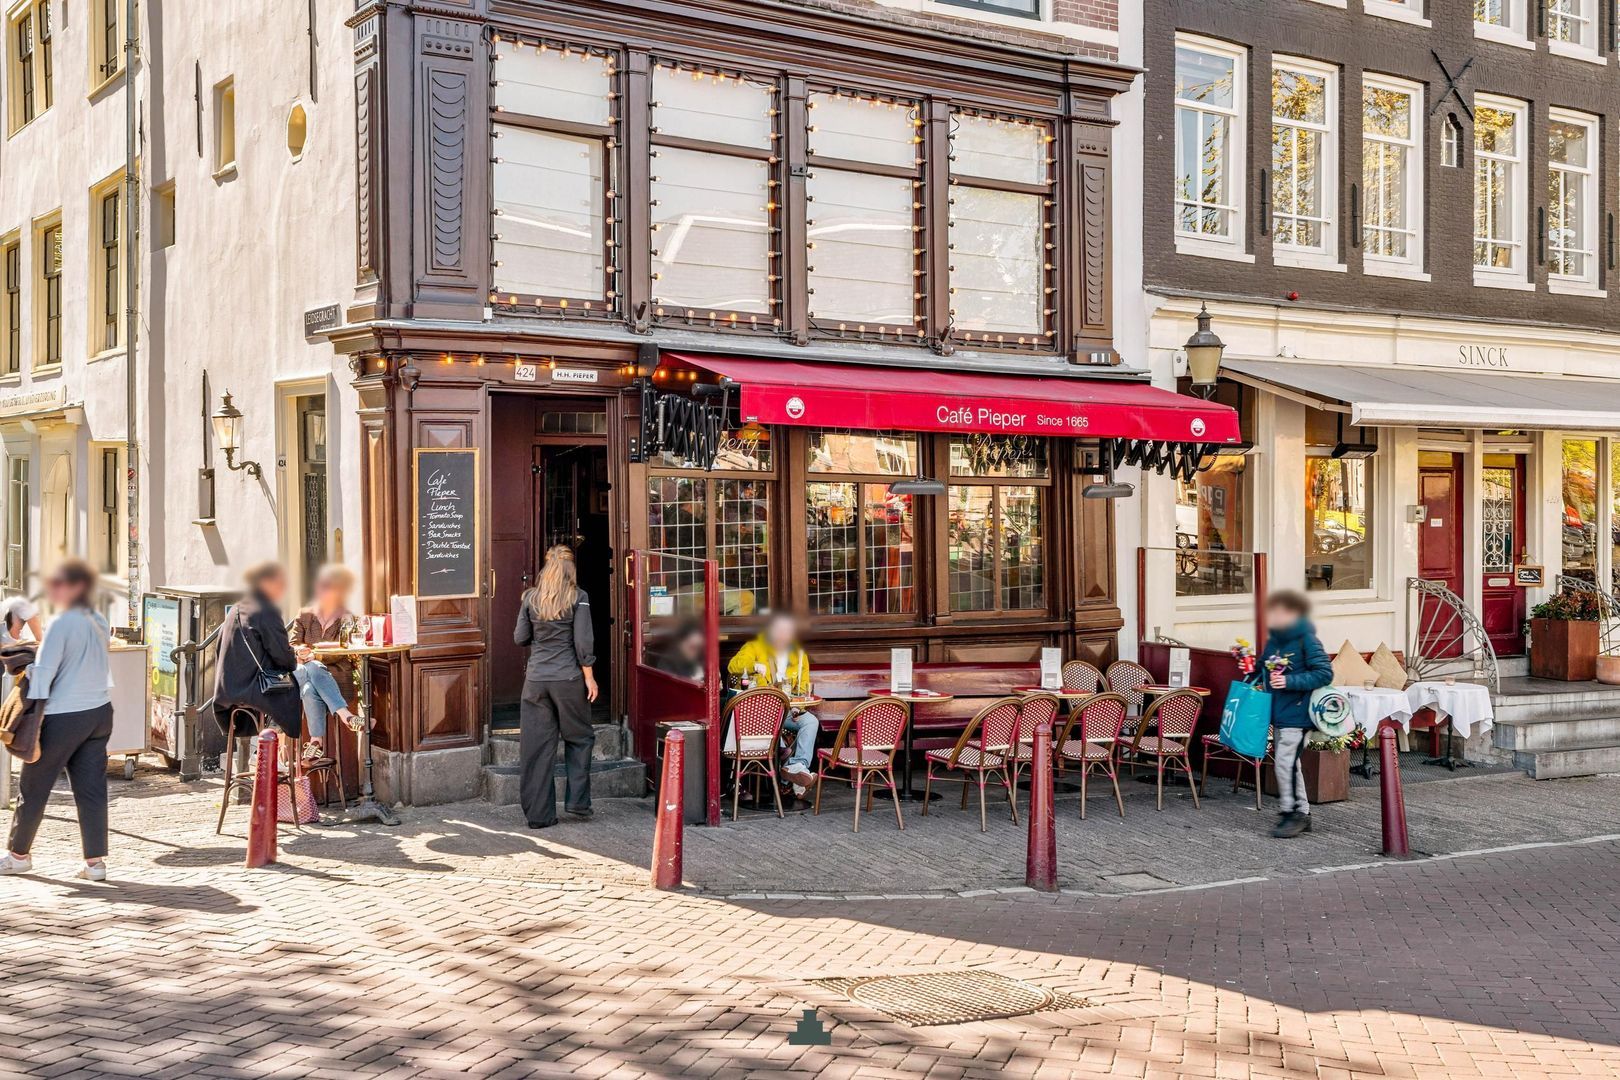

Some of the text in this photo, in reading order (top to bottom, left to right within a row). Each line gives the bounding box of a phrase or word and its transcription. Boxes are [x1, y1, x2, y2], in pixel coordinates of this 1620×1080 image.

[1459, 345, 1508, 367] SINCK
[516, 367, 535, 378] 424
[936, 405, 1027, 429] Café Pieper
[1036, 414, 1089, 428] Since 1665
[427, 469, 451, 490] Café
[431, 501, 455, 511] Lunch
[427, 511, 463, 520] Tomato Soup
[441, 530, 462, 538] Snacks
[426, 540, 450, 549] Double
